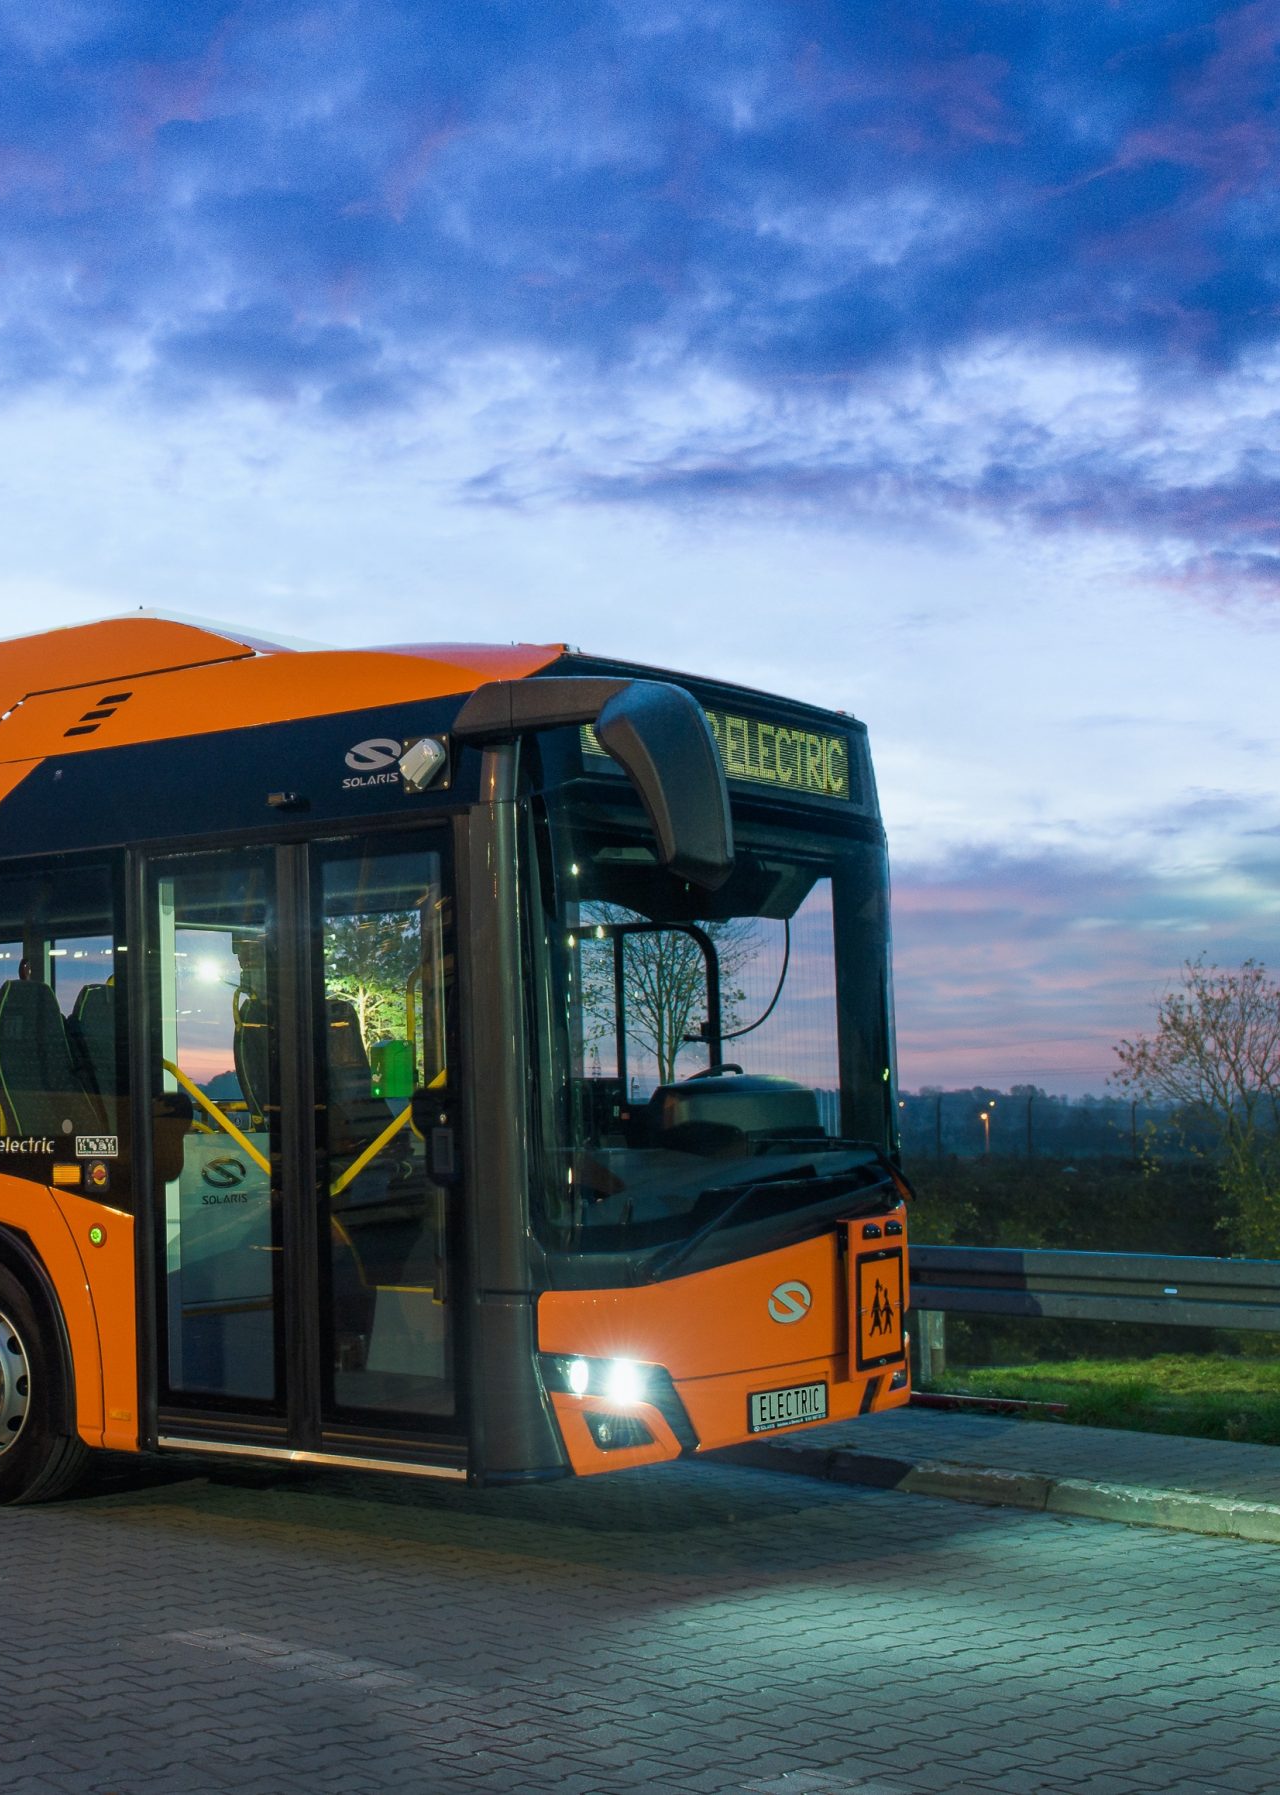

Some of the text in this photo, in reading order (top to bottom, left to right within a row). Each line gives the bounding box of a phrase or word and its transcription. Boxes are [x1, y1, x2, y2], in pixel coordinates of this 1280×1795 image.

[725, 716, 844, 792] ELECTRIC
[342, 772, 399, 789] SOLARIS
[202, 1193, 248, 1205] SOLARIS
[760, 1387, 819, 1422] ELECTRIC
